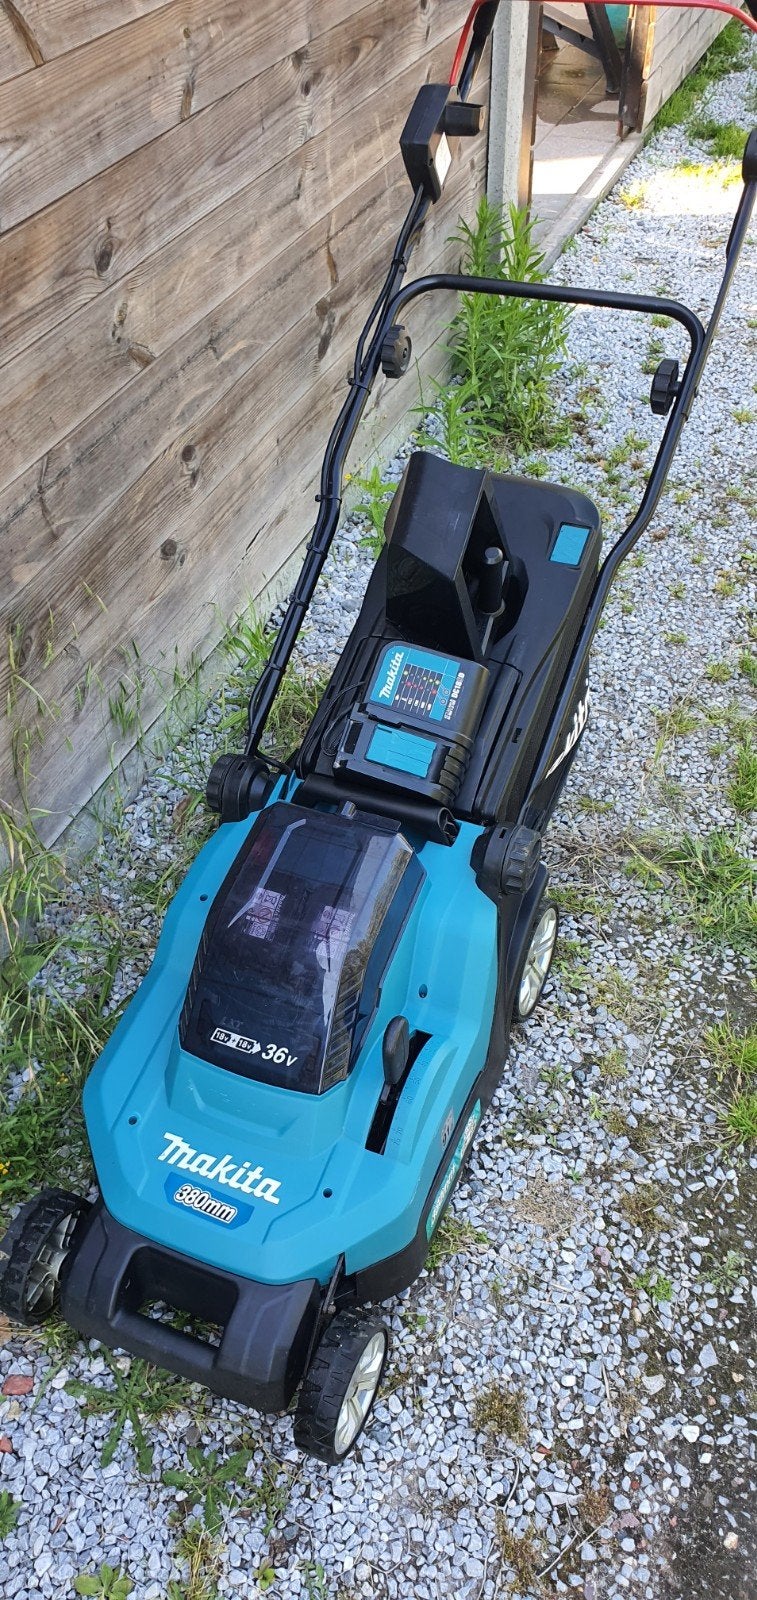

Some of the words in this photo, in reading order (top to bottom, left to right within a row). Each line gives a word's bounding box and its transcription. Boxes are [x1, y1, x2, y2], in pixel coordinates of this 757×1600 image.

[379, 652, 404, 699] Makita
[545, 687, 589, 779] kita
[157, 1132, 281, 1205] Makita
[174, 1184, 237, 1223] 380mm
